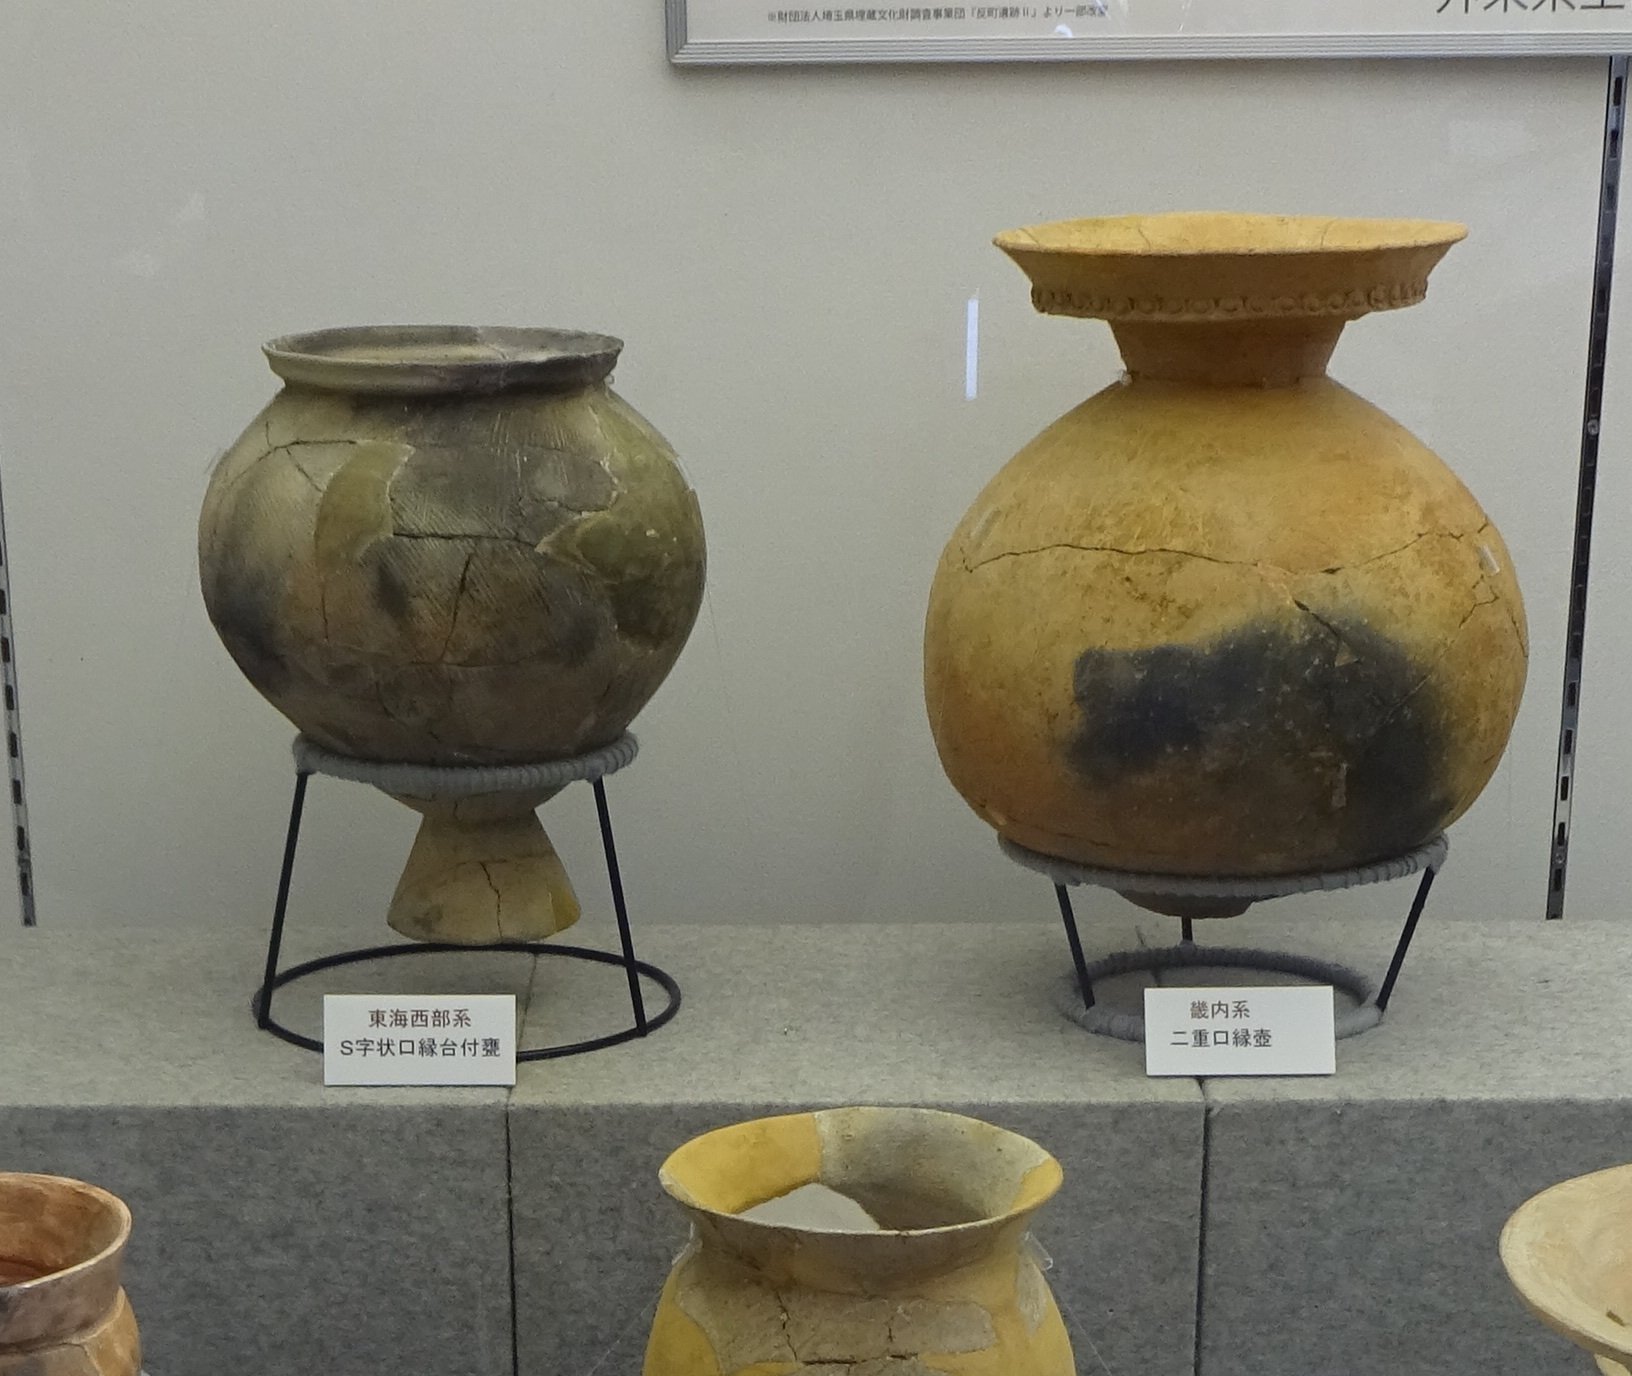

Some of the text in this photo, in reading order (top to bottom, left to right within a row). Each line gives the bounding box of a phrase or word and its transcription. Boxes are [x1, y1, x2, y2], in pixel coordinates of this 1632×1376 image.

[369, 1009, 472, 1029] 東海西部系
[1190, 1000, 1250, 1020] 畿内系
[340, 1038, 501, 1058] S字状口縁台付甕
[1170, 1029, 1272, 1048] 二重口縁壺
